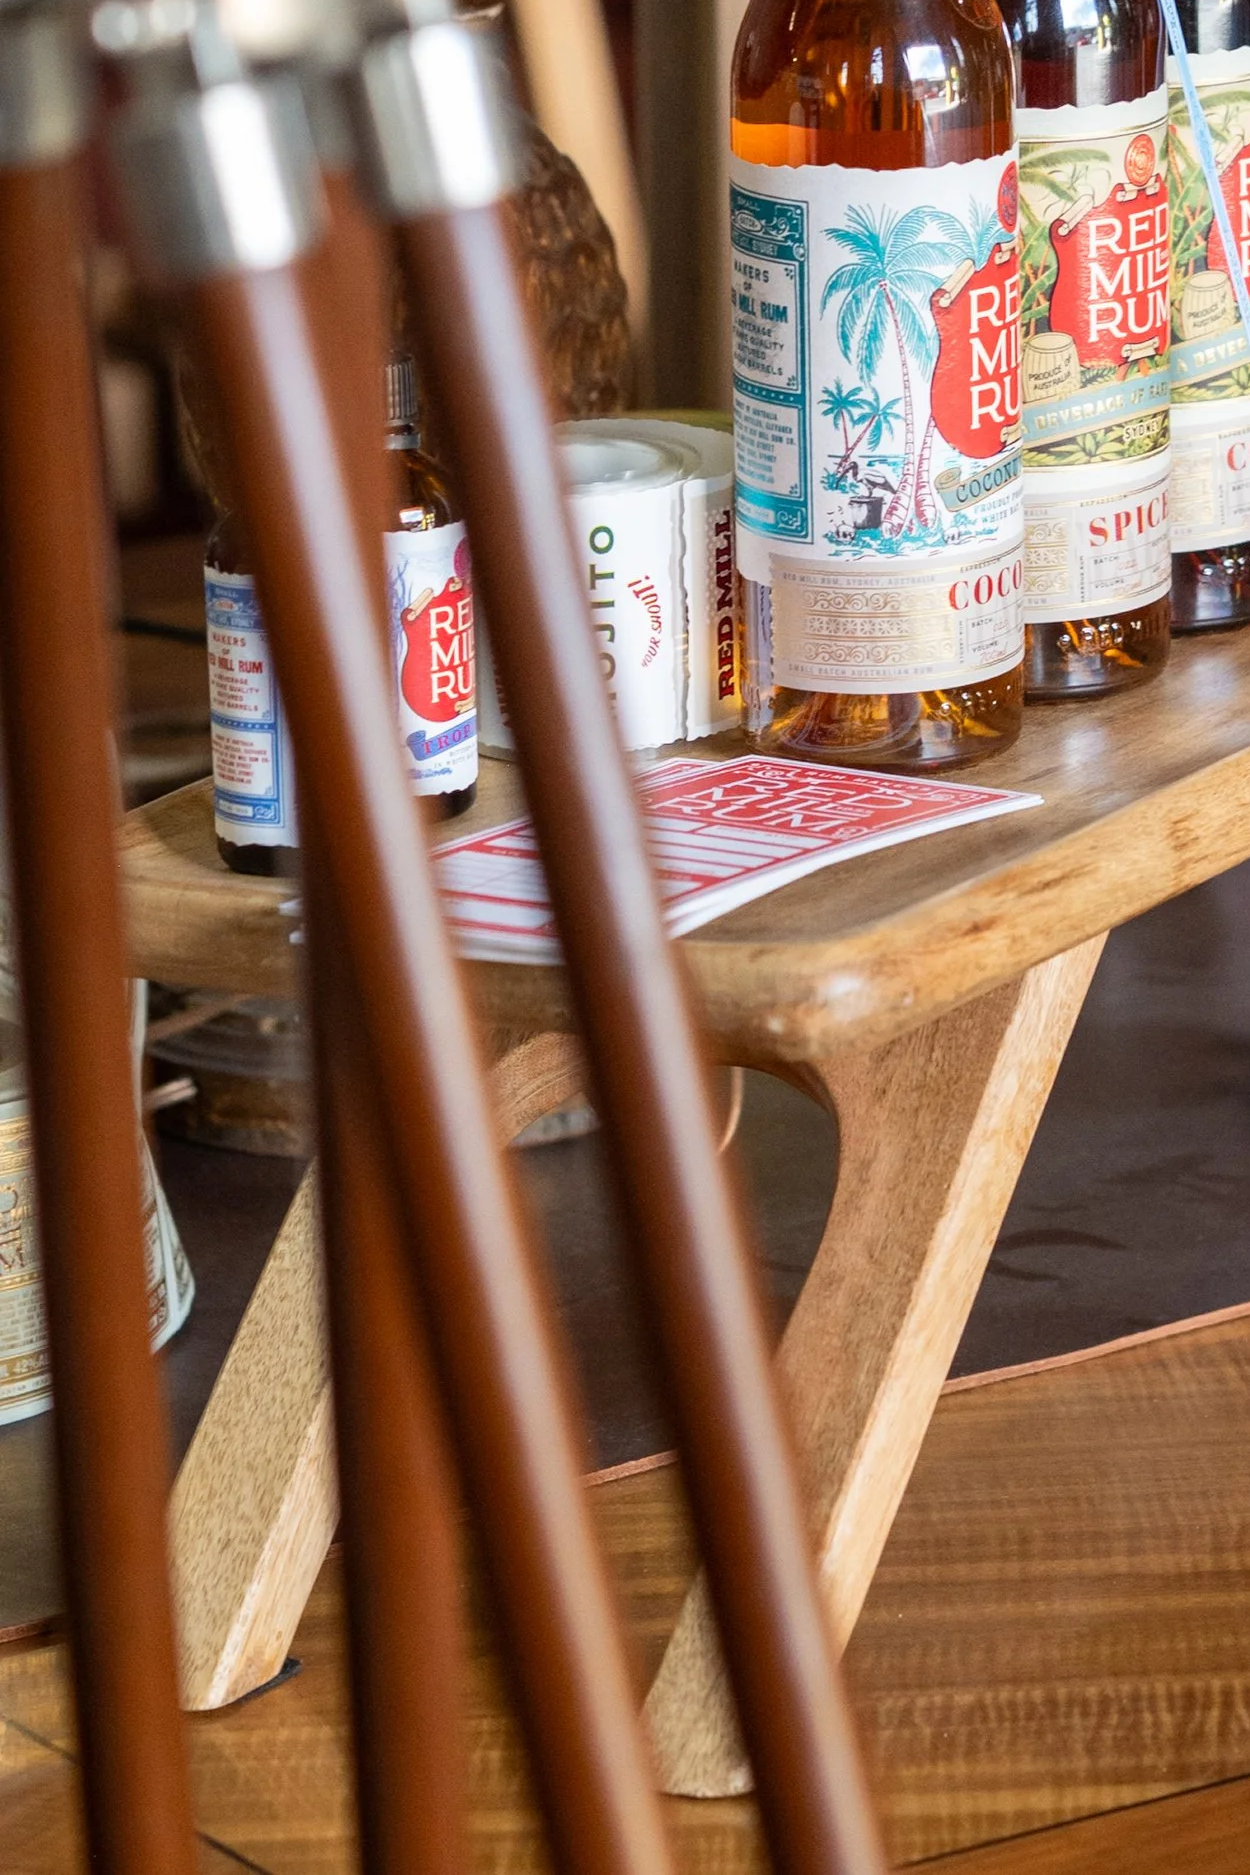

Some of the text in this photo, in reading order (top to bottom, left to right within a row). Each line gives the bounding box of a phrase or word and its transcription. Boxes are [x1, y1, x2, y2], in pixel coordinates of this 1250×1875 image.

[1087, 202, 1169, 259] RED
[760, 300, 789, 324] RUM
[1028, 365, 1063, 382] PRODUCE
[1033, 370, 1071, 391] AUSTRALIA
[1034, 394, 1126, 430] BEVERAGE
[1124, 416, 1162, 440] SYDNEY
[887, 575, 936, 586] AUSTRALIA
[948, 559, 1022, 611] COCO
[627, 575, 663, 669] YOUR SHOUT!
[714, 510, 736, 701] RED MILL
[971, 617, 994, 628] BATCH
[589, 525, 616, 722] OJITO
[238, 659, 264, 675] RUM
[850, 666, 910, 677] AUSTRALIAN
[689, 786, 876, 823] MILL
[722, 776, 914, 810] RED
[652, 796, 853, 833] RUM
